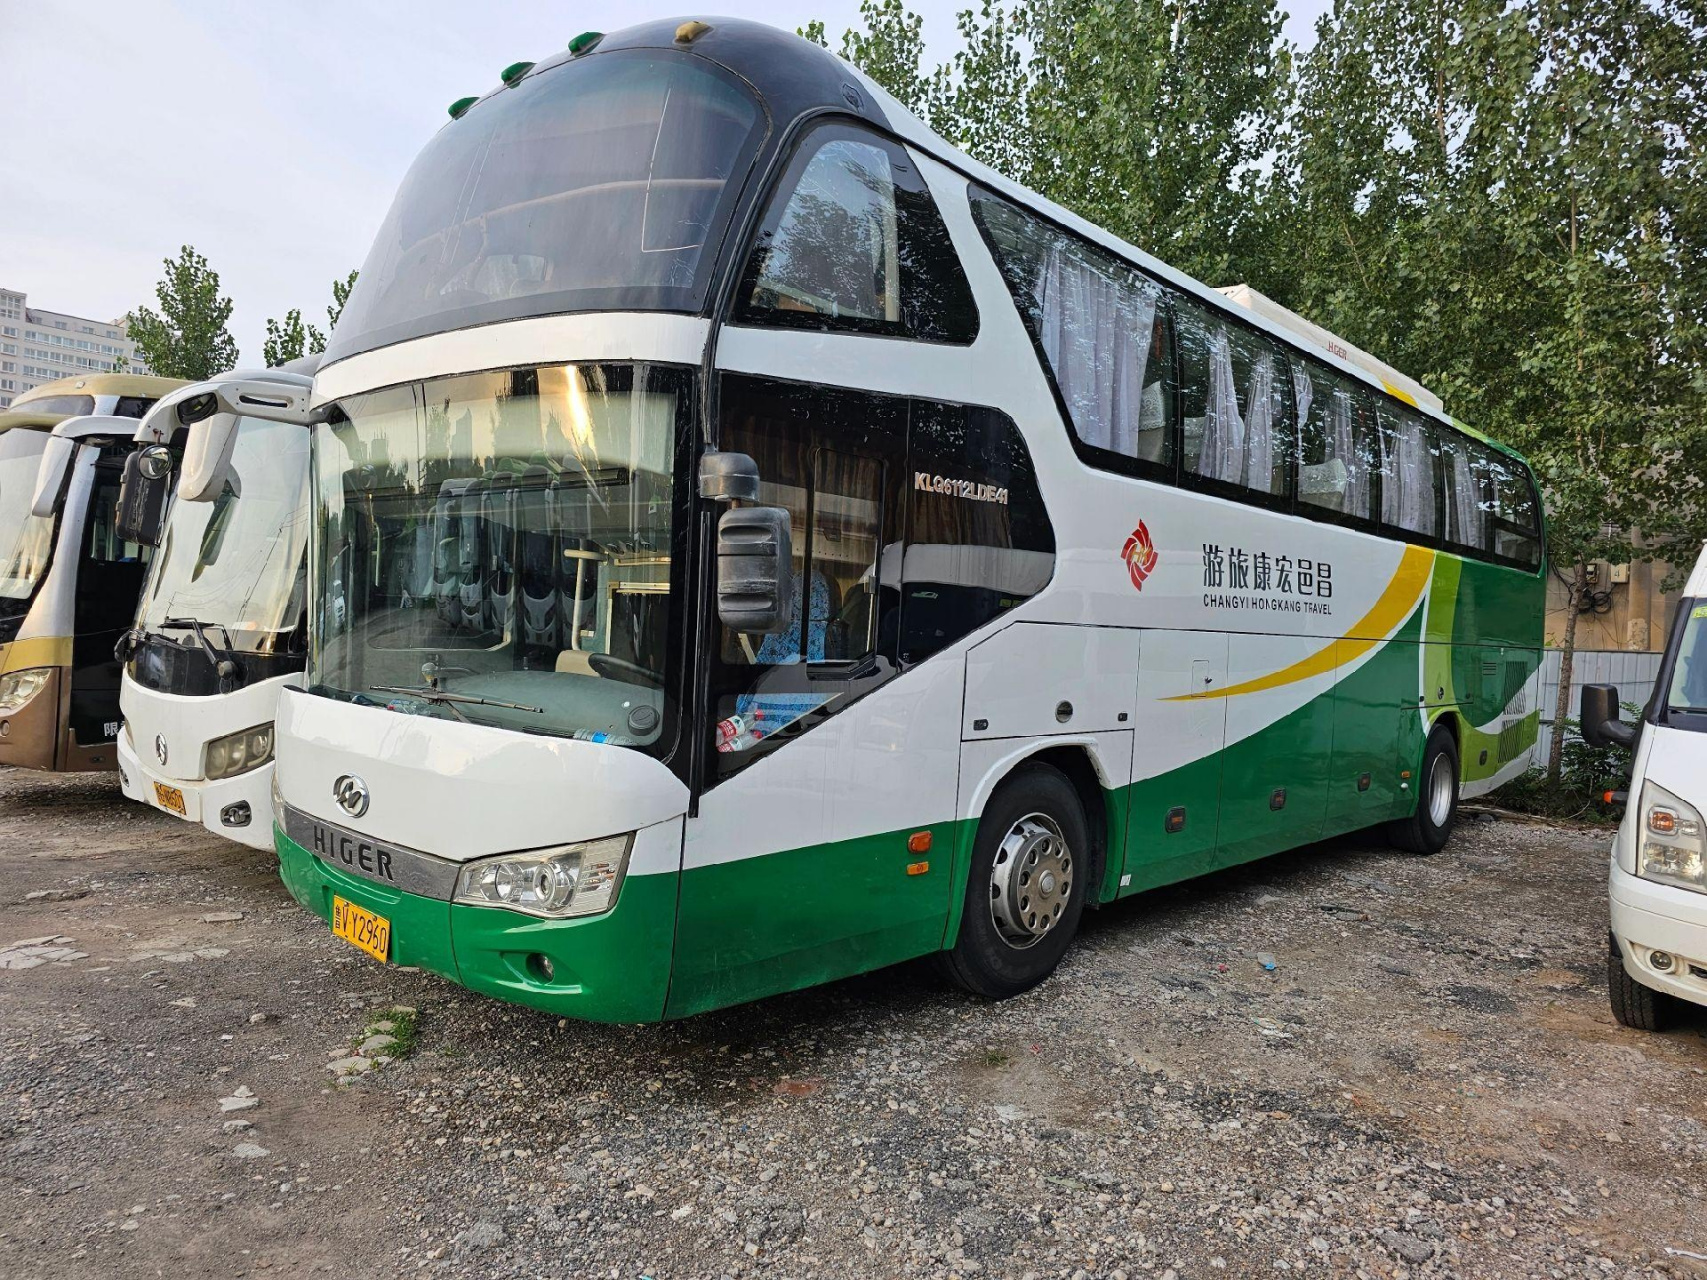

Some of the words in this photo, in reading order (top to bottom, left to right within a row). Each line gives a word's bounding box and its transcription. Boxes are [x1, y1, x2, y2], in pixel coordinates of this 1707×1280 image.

[915, 471, 1008, 505] KLQ6112LDE41
[1203, 593, 1249, 609] CHANGYI
[1251, 596, 1301, 613] HONGKANG
[1303, 601, 1332, 616] TRAVEL
[313, 825, 395, 882] HIGER
